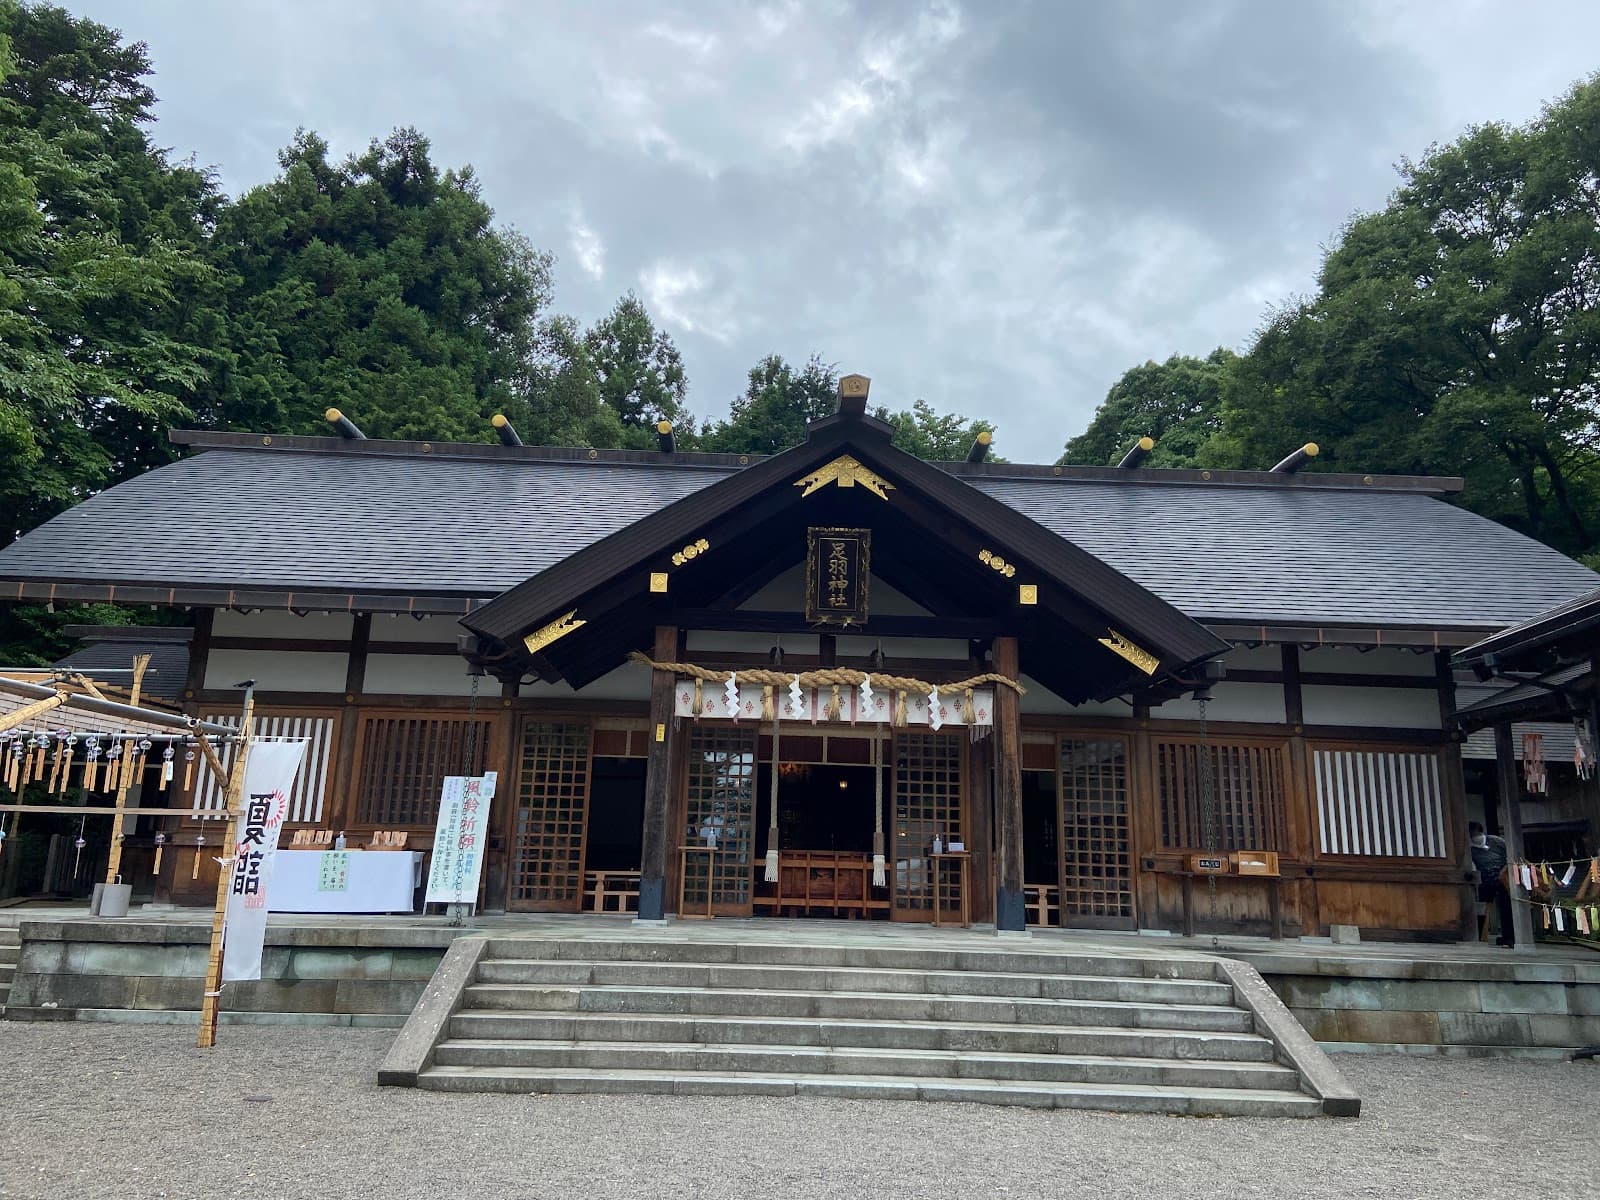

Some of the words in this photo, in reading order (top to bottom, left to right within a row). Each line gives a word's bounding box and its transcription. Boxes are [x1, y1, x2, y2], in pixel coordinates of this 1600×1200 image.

[827, 542, 849, 607] 足羽神社
[233, 793, 275, 895] 夏詣
